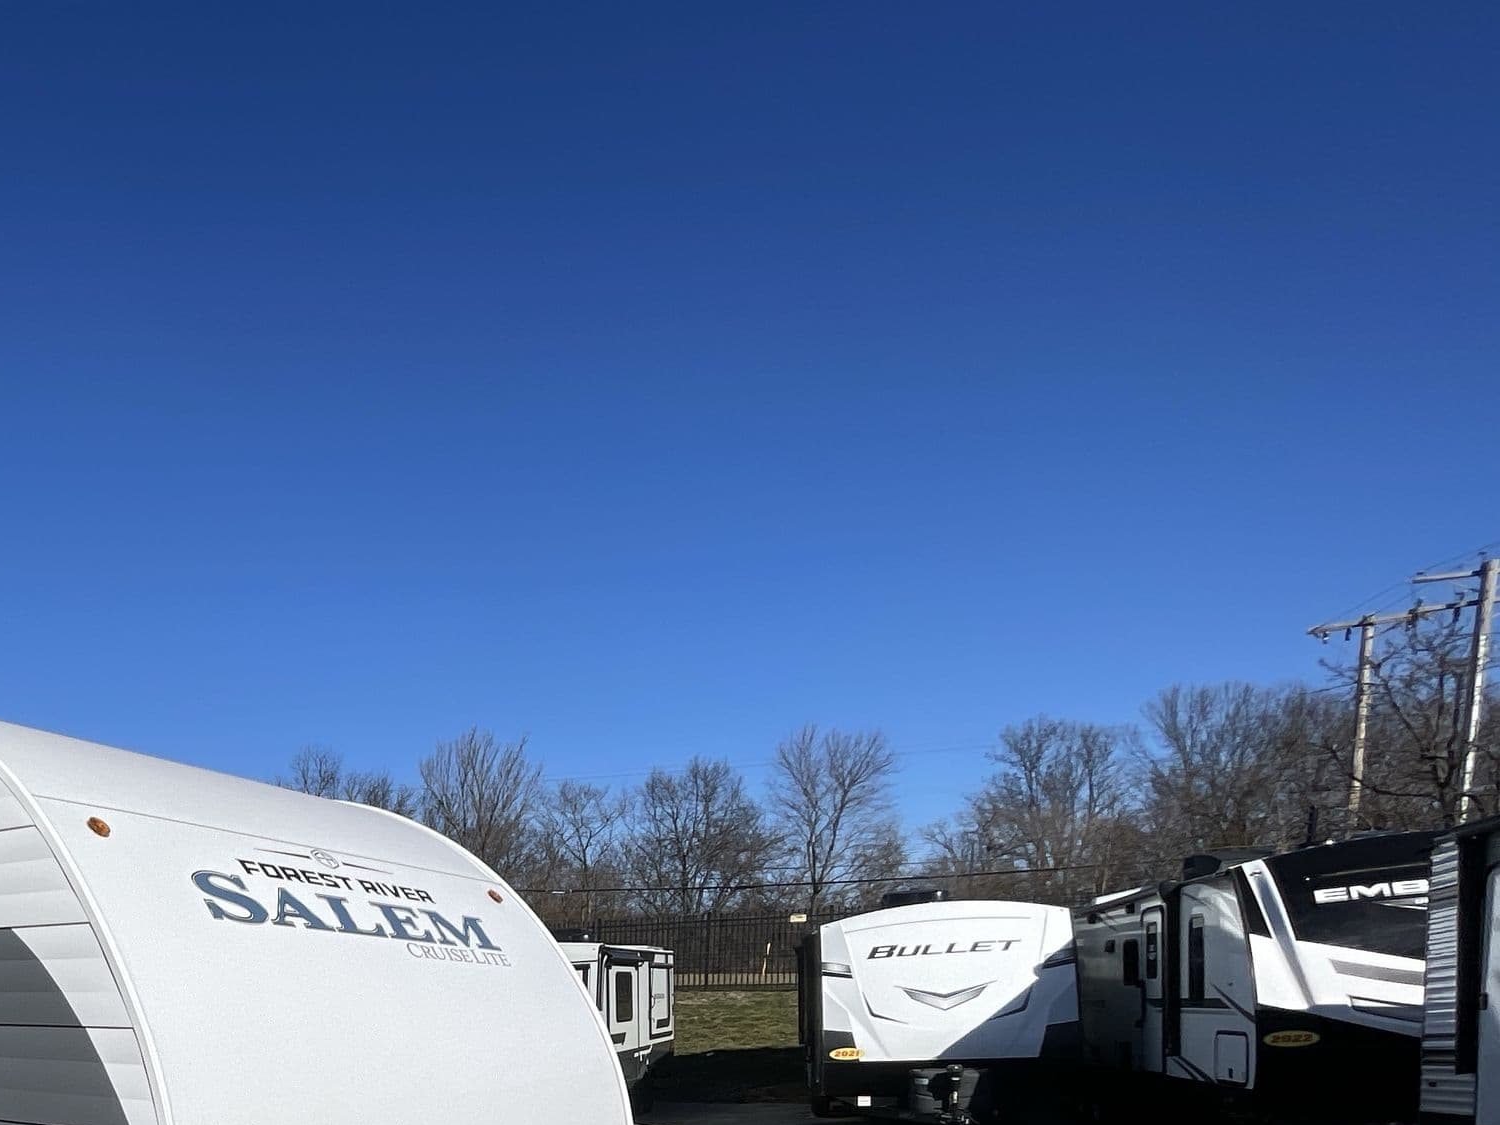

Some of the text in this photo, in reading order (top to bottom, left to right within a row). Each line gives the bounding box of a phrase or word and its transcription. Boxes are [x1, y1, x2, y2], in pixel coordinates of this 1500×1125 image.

[236, 859, 435, 903] FOREST RIVER
[190, 869, 503, 952] SALEM
[867, 939, 1022, 960] BULLET
